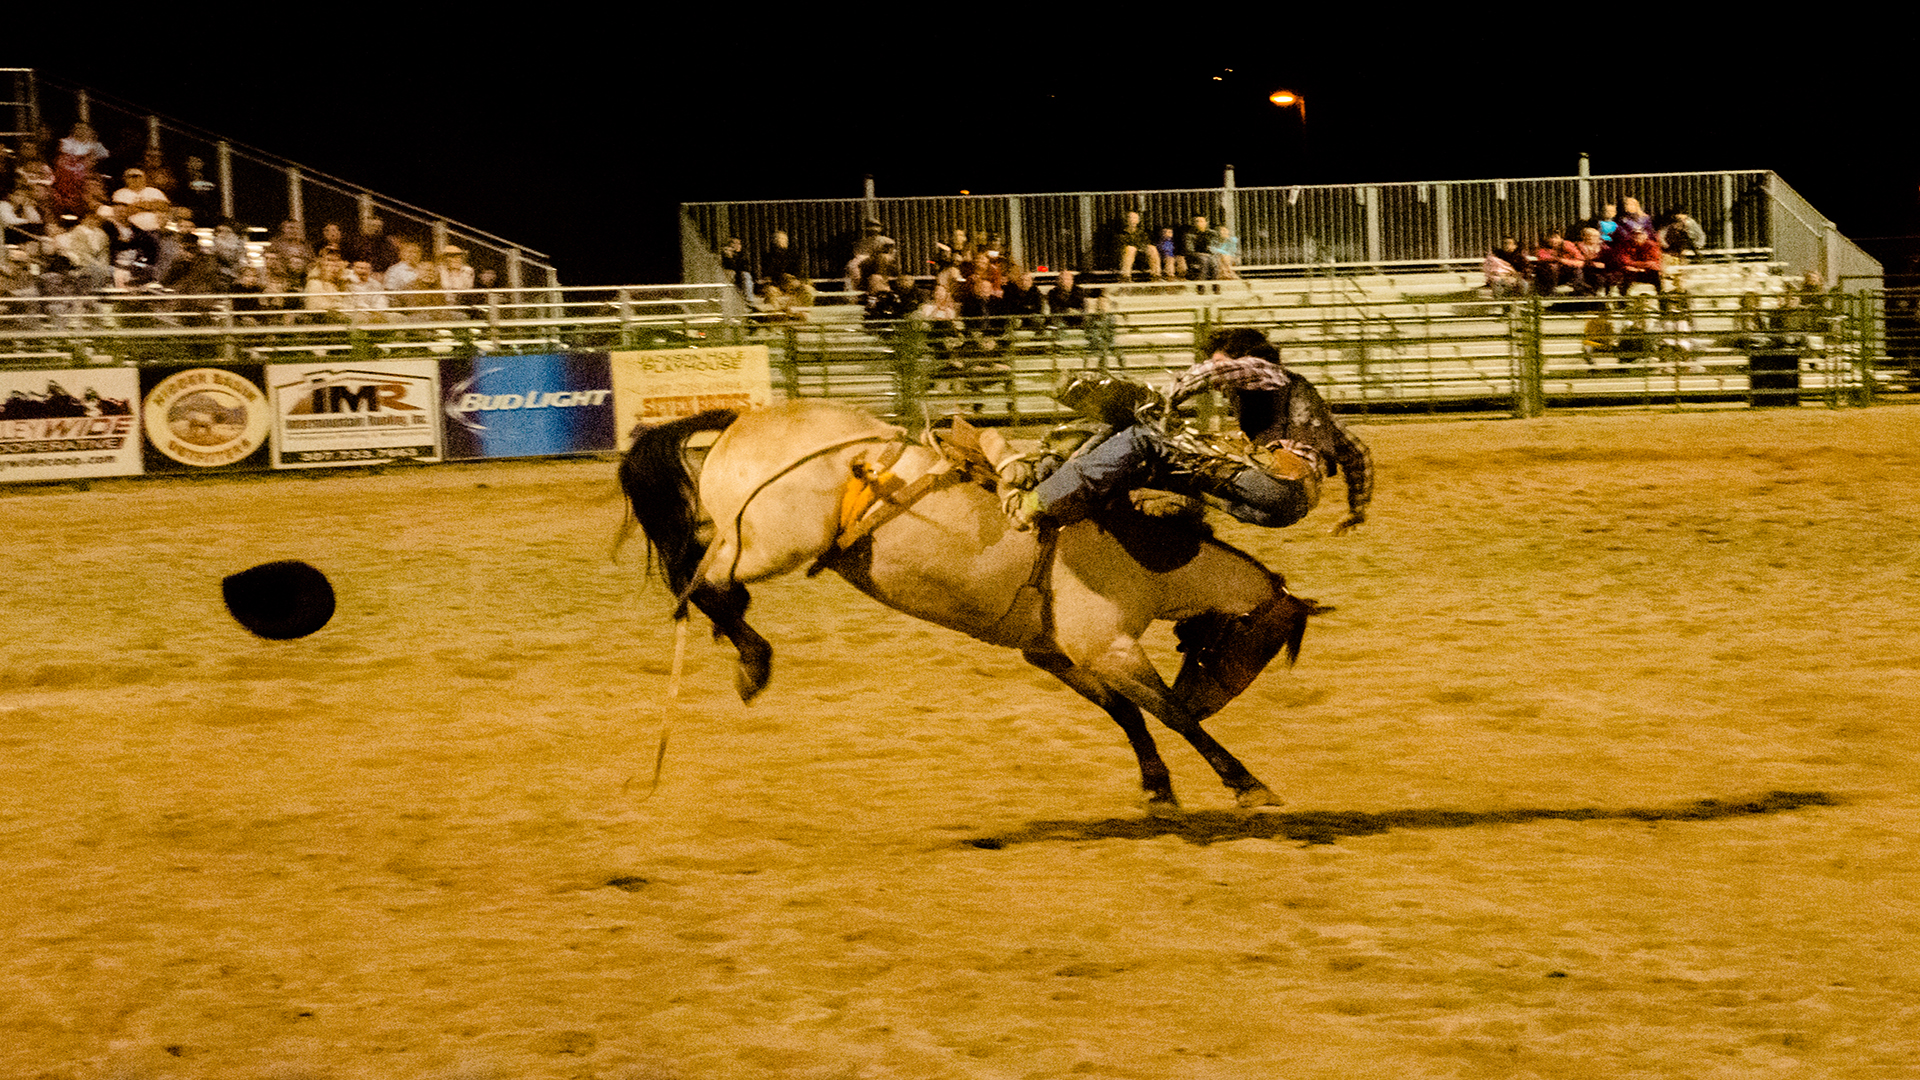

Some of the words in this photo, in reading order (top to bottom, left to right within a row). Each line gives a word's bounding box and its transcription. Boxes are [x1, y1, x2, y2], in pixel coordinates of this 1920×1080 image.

[637, 353, 700, 365] JACKSON
[706, 351, 744, 363] HOLE
[642, 361, 743, 373] PLAYHOUSE
[312, 384, 426, 414] IMR
[459, 393, 523, 412] BUD
[524, 390, 612, 409] LIGHT
